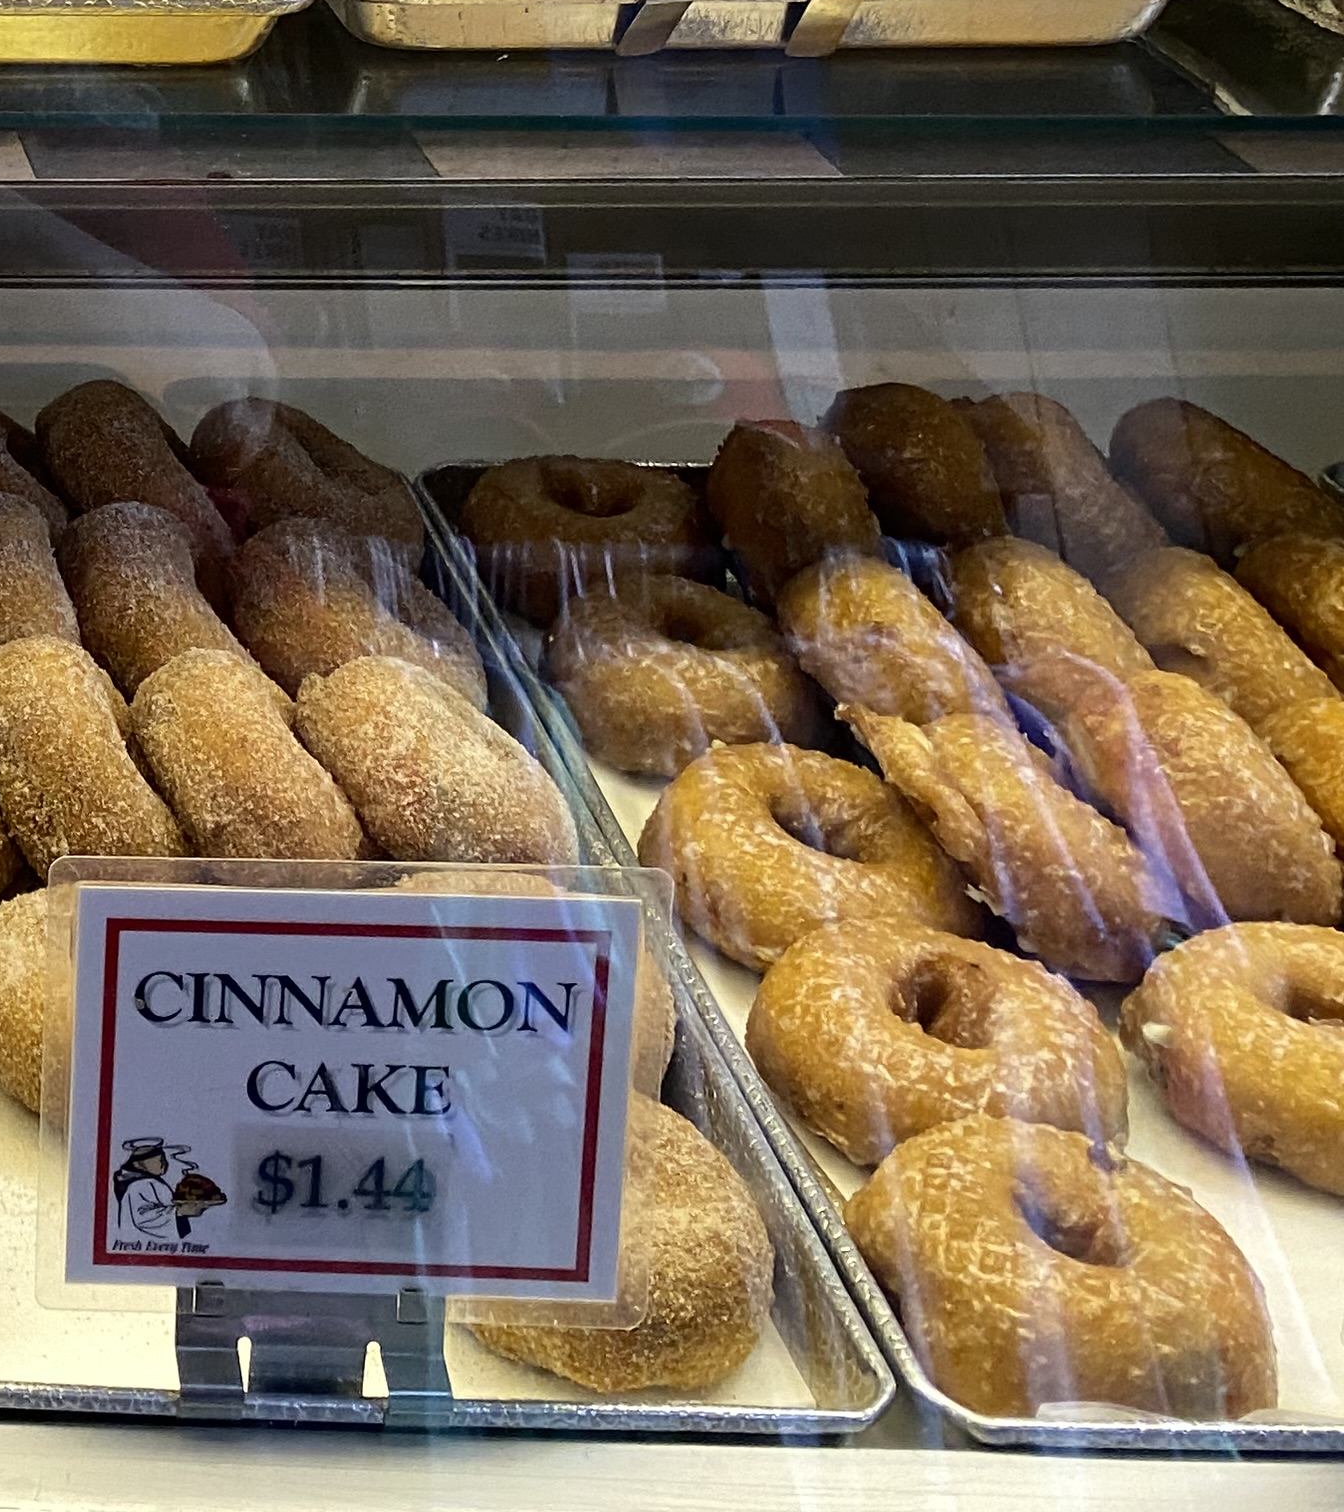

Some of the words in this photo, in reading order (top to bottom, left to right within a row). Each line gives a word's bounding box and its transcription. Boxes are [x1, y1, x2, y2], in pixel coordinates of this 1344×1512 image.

[134, 970, 578, 1033] CINNAMON
[246, 1060, 452, 1115] CAKE
[255, 1150, 437, 1215] $1.44
